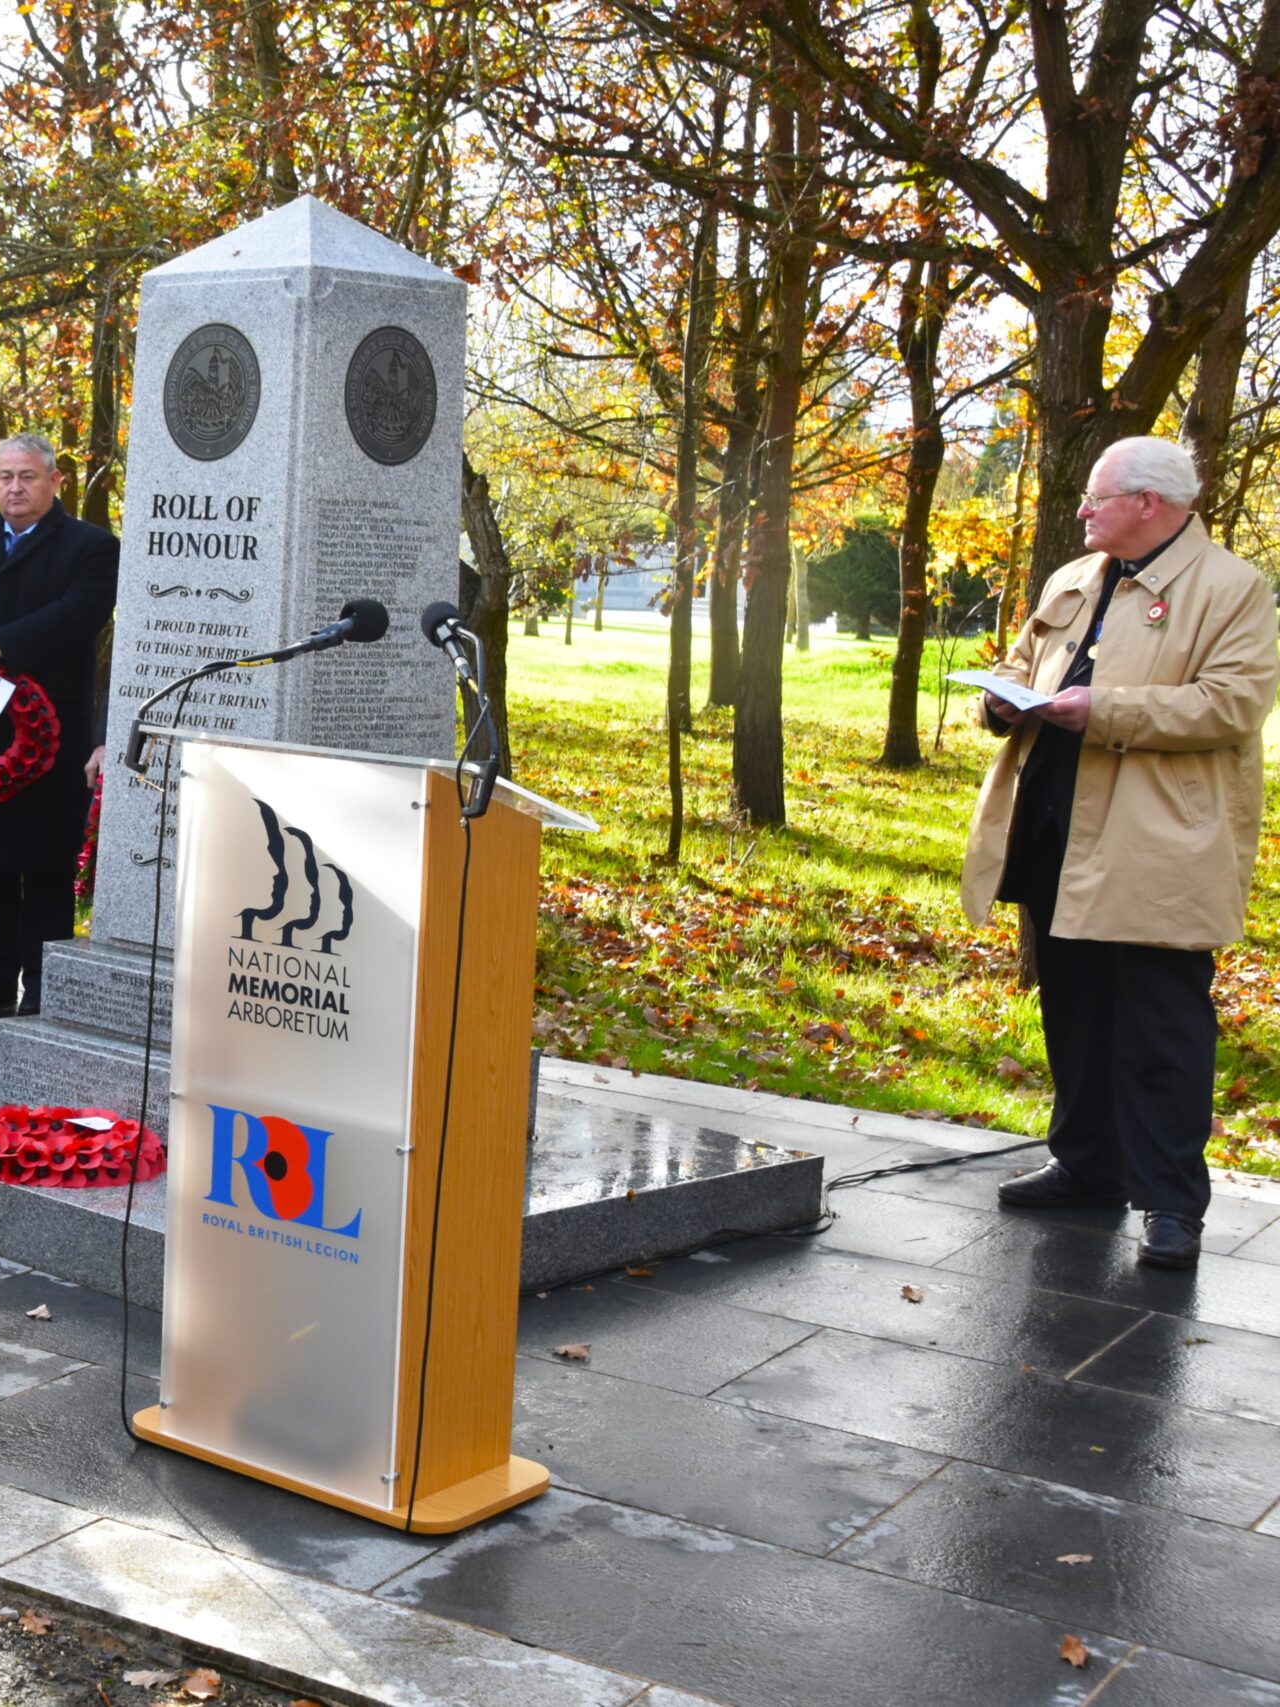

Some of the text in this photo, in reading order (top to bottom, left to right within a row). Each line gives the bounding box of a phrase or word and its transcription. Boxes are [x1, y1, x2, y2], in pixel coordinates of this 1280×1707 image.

[151, 494, 261, 522] ROLL OF
[147, 531, 258, 560] HONOUR
[144, 619, 251, 638] A PROUD TRIBUTE
[136, 640, 151, 653] TO
[154, 641, 194, 657] THOSE
[135, 663, 253, 686] OF THE SHWMEN'S
[118, 685, 156, 699] GUILD
[176, 690, 216, 706] GREAT
[218, 691, 270, 709] BRITAIN
[144, 711, 173, 724] WHO
[214, 716, 238, 731] THE
[155, 802, 177, 816] 114
[154, 824, 177, 838] 139
[228, 946, 351, 988] NATIONAL
[228, 973, 350, 1015] MEMORIAL
[227, 999, 349, 1042] ARBORETUM
[202, 1212, 360, 1264] ROYAL BRITISH LEGION
